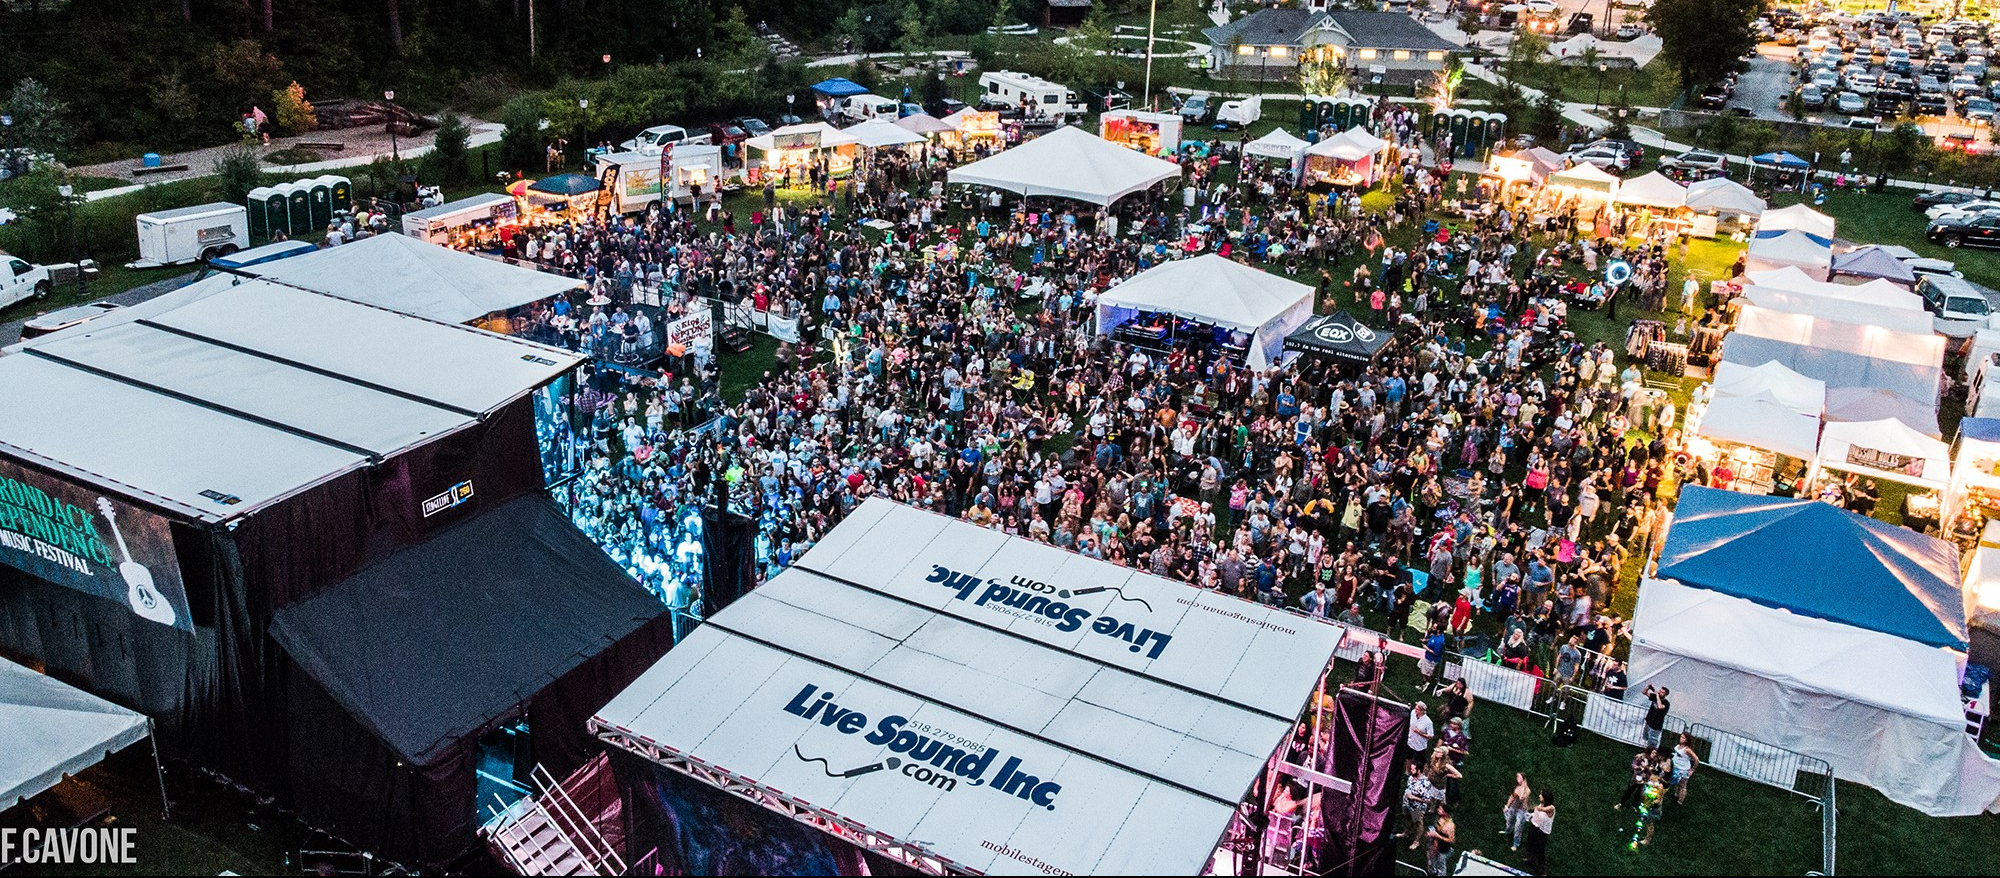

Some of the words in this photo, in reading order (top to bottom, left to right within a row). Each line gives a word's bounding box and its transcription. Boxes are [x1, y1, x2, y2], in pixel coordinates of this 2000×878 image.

[1320, 328, 1349, 340] EQX
[1336, 351, 1369, 362] alternative
[33, 539, 94, 576] FESTIVAL
[925, 564, 983, 601] Inc.
[1010, 575, 1057, 595] com
[986, 602, 1052, 627] 518.279.9085
[1176, 598, 1297, 636] mobilestageman.com
[1092, 616, 1173, 660] Live
[783, 683, 868, 734] Live
[864, 715, 999, 786] Sound,
[989, 756, 1063, 811] Inc.
[909, 719, 985, 753] 518.279.9085
[902, 763, 958, 792] com
